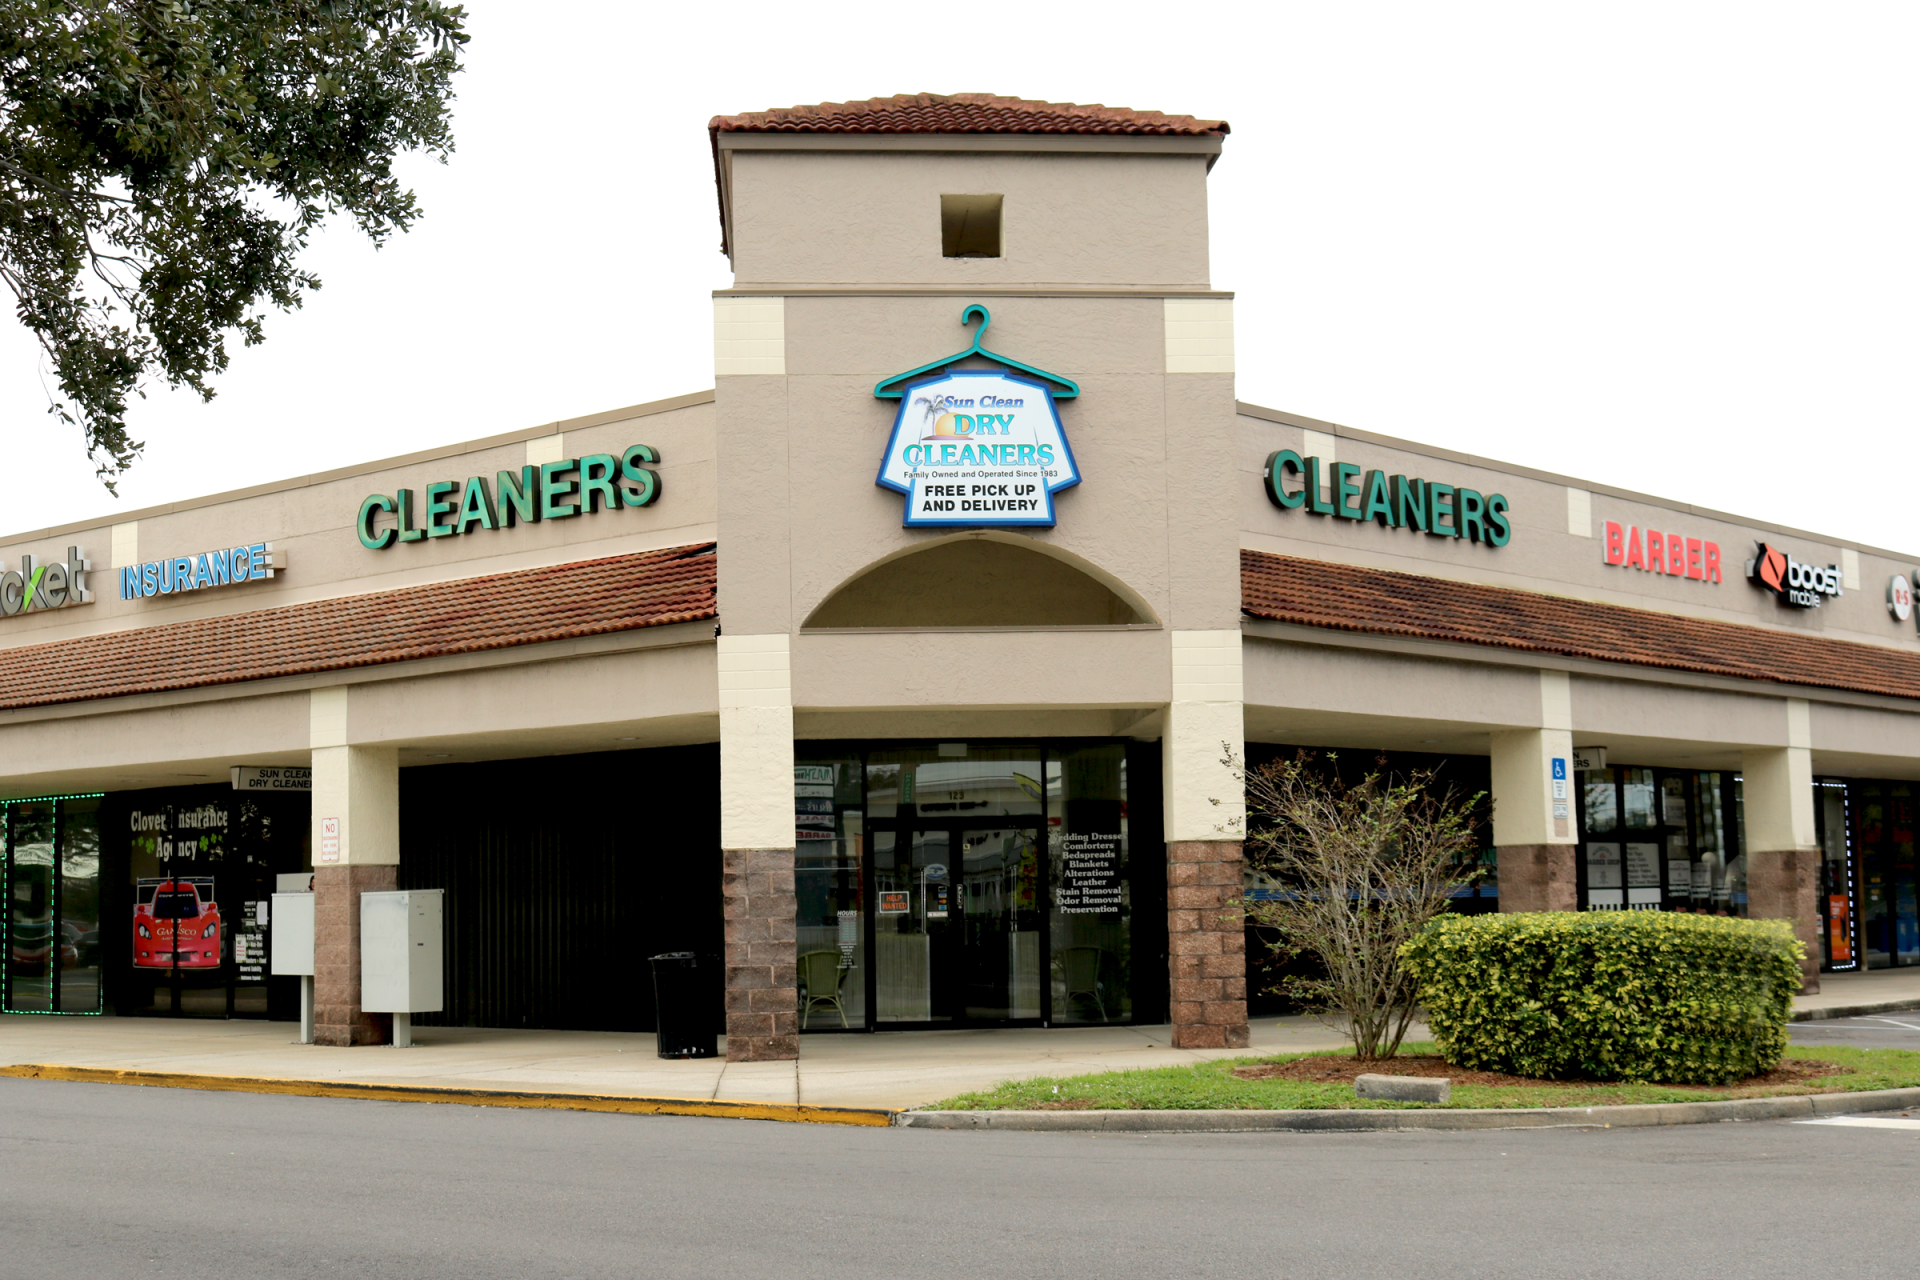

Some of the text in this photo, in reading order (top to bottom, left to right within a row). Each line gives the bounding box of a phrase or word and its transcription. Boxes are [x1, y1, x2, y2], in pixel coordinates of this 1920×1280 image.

[943, 395, 1024, 408] Sun Clean
[954, 414, 1015, 435] DRY
[902, 443, 1055, 466] CLEANERS
[903, 471, 929, 480] Family
[978, 470, 1014, 479] Operated
[1016, 470, 1038, 478] Since
[1040, 470, 1058, 478] 1983
[924, 484, 1036, 497] FREE PICK UP
[357, 444, 661, 550] CLEANERS
[1264, 449, 1511, 547] CLEANERS
[922, 499, 1038, 512] AND DELIVERY
[1603, 520, 1722, 584] BARBER
[120, 542, 271, 600] INSURANCE
[1787, 553, 1843, 597] boost
[0, 546, 91, 615] cket
[1789, 589, 1821, 608] mobile
[259, 769, 279, 778] SUN
[249, 779, 312, 788] DRY CLEANE
[949, 791, 965, 800] 123
[130, 810, 167, 832] Clover
[325, 823, 336, 833] NO
[1091, 832, 1127, 841] Dresses
[1063, 842, 1115, 850] Comforters
[1062, 850, 1116, 860] Bedspreads
[1069, 860, 1110, 868] Blankets
[1064, 869, 1115, 878] Alterations
[1072, 878, 1108, 887] Leather
[1056, 886, 1122, 896] Stain Removal
[886, 894, 903, 902] HELP
[1056, 895, 1122, 905] Odor Removal
[882, 902, 908, 910] WANTED
[1060, 905, 1119, 914] Preservation
